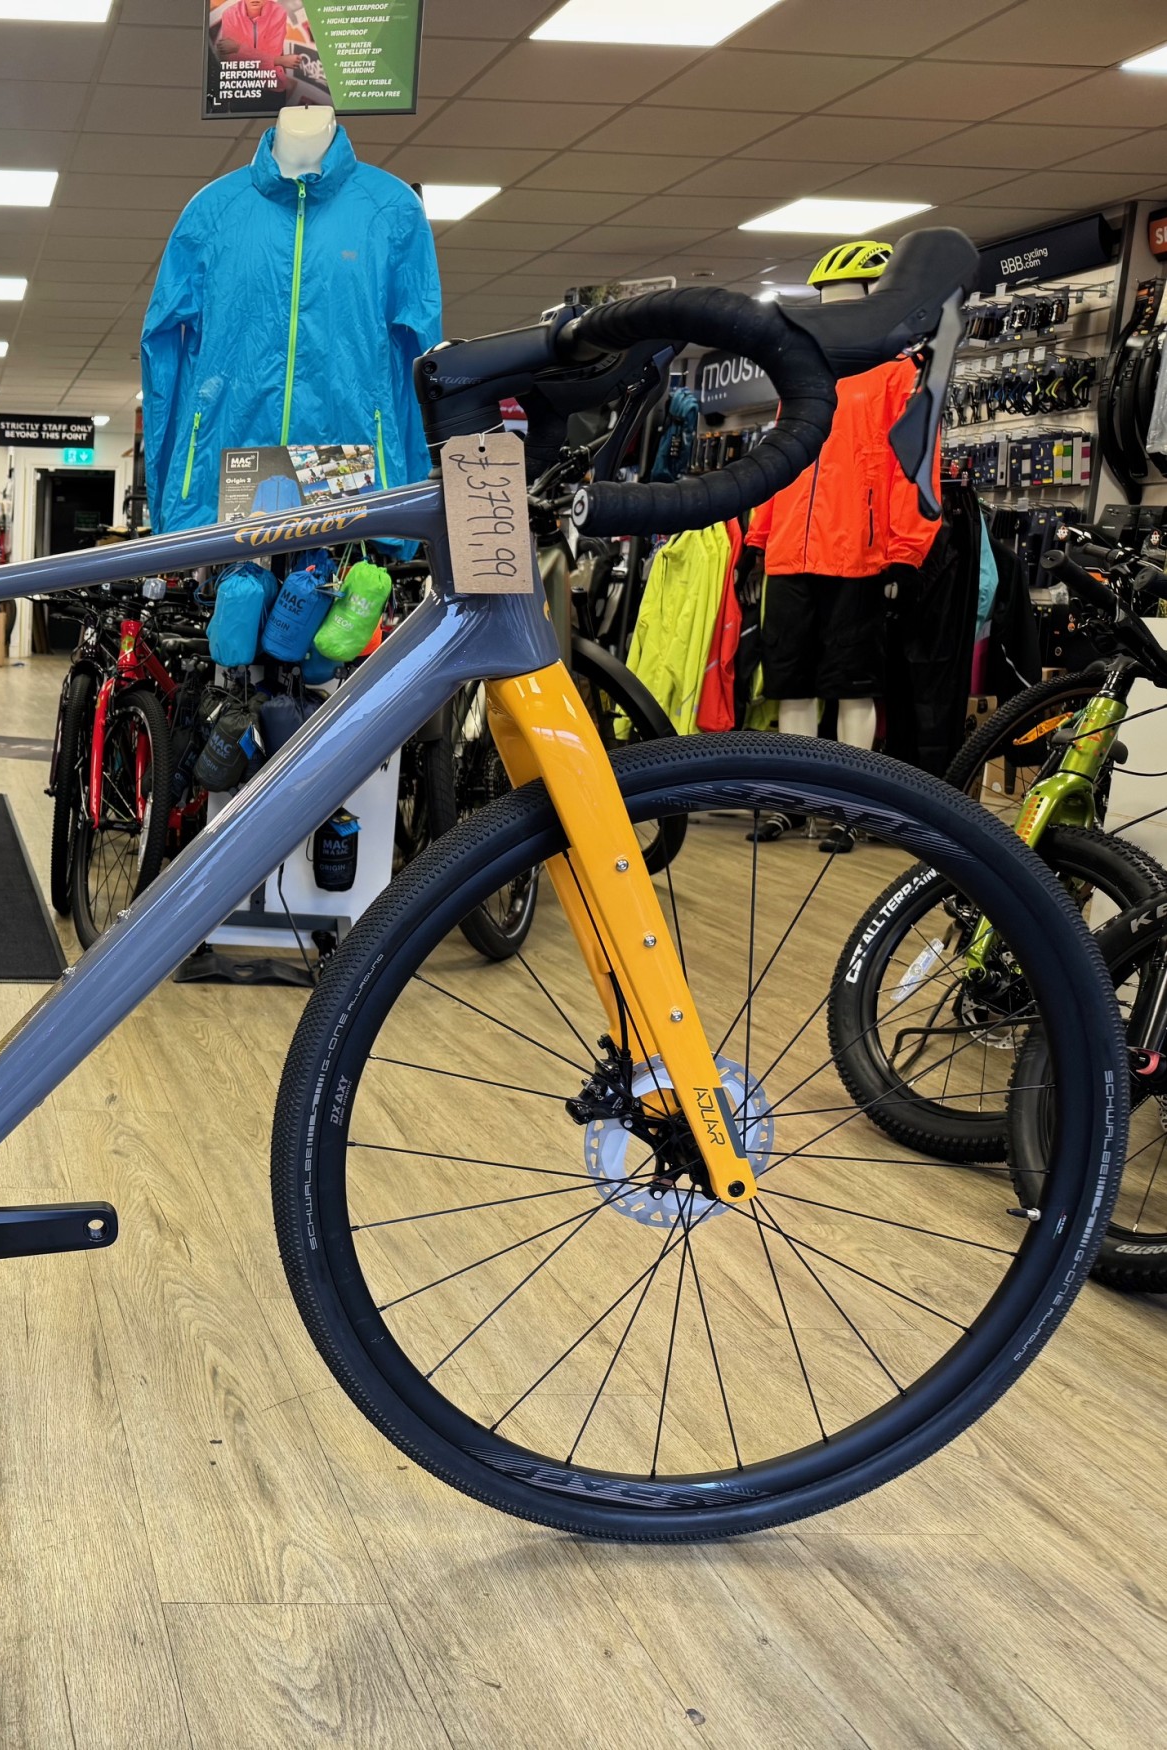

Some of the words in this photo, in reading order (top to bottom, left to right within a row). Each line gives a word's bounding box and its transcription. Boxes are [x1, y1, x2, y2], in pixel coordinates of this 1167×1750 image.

[347, 3, 389, 11] WATERPROOF
[220, 61, 238, 70] THE
[239, 60, 261, 69] BEST
[220, 70, 276, 79] PERFORMING
[220, 80, 266, 89] PACKAWAY
[268, 79, 277, 88] IN
[220, 90, 233, 99] ITS
[234, 90, 262, 98] CLASS
[1023, 247, 1048, 262] cycling
[0, 421, 40, 430] STRICTLY
[42, 423, 68, 431] STAFF
[70, 424, 93, 432] ONLY
[5, 430, 39, 439] BEYOND
[41, 432, 60, 440] THIS
[61, 433, 88, 441] POINT
[230, 457, 252, 465] MAC
[234, 513, 368, 547] Wilier
[280, 588, 306, 610] MAC
[211, 731, 233, 753] MAC
[323, 839, 348, 849] MAC
[859, 917, 886, 946] ALL
[347, 953, 385, 1010] ALLROUND
[321, 1012, 349, 1071] G-ONE
[335, 1074, 349, 1103] AXY
[330, 1104, 340, 1125] DX
[693, 1087, 726, 1145] ADLAR
[1099, 1070, 1114, 1176] SCHWALBE
[304, 1146, 318, 1250] SCHWALBE
[1052, 1249, 1085, 1307] G-ONE
[1014, 1306, 1055, 1361] ALLROUND
